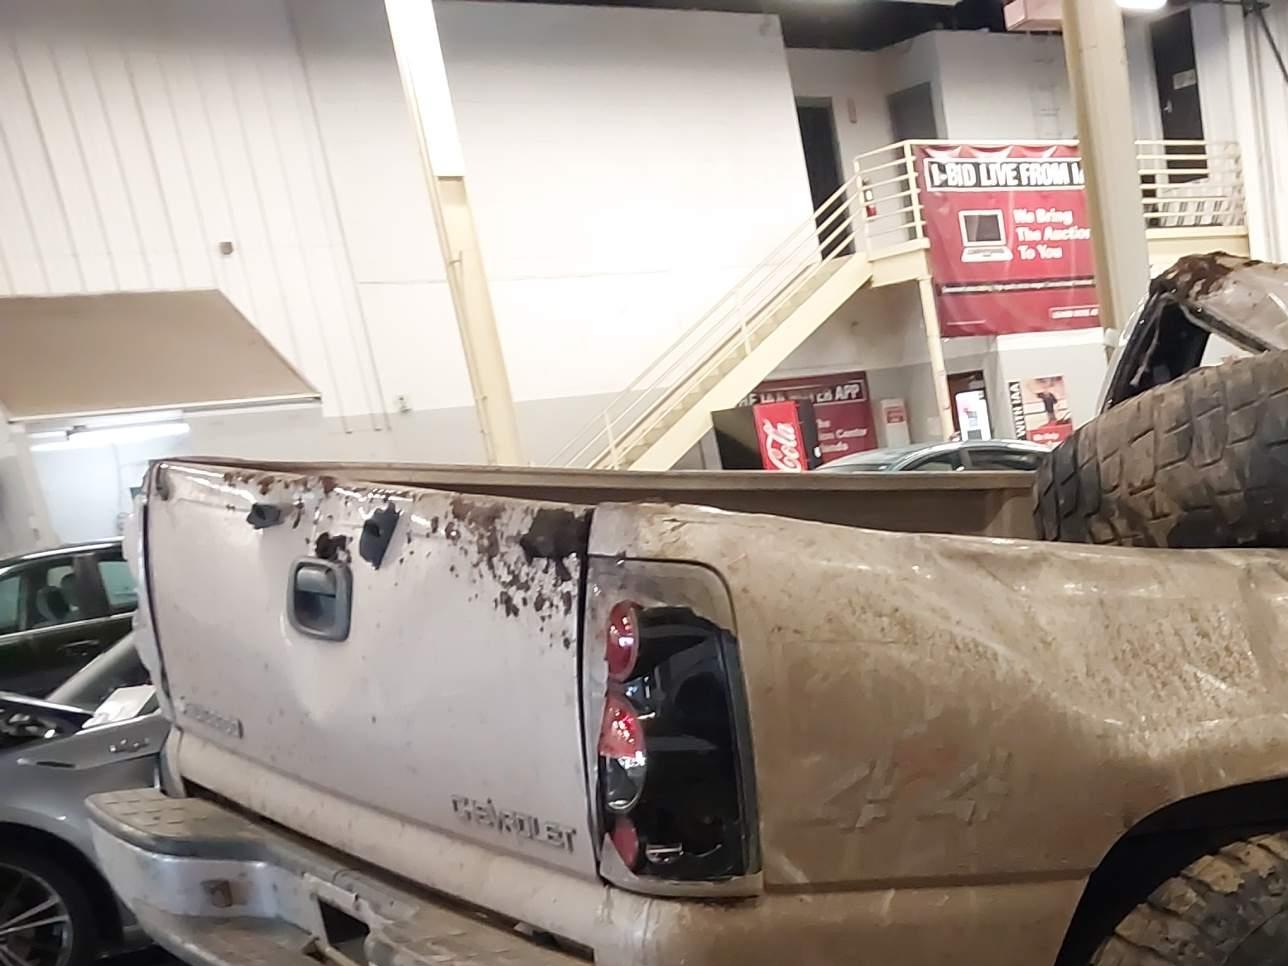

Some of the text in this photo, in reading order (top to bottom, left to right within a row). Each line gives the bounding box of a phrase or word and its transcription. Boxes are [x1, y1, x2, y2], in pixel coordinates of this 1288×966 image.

[930, 162, 977, 186] I-BID
[979, 162, 1019, 186] LIVE
[1019, 162, 1070, 185] FROM
[1036, 208, 1073, 225] Bring
[1016, 226, 1041, 241] The
[1018, 244, 1063, 260] To You
